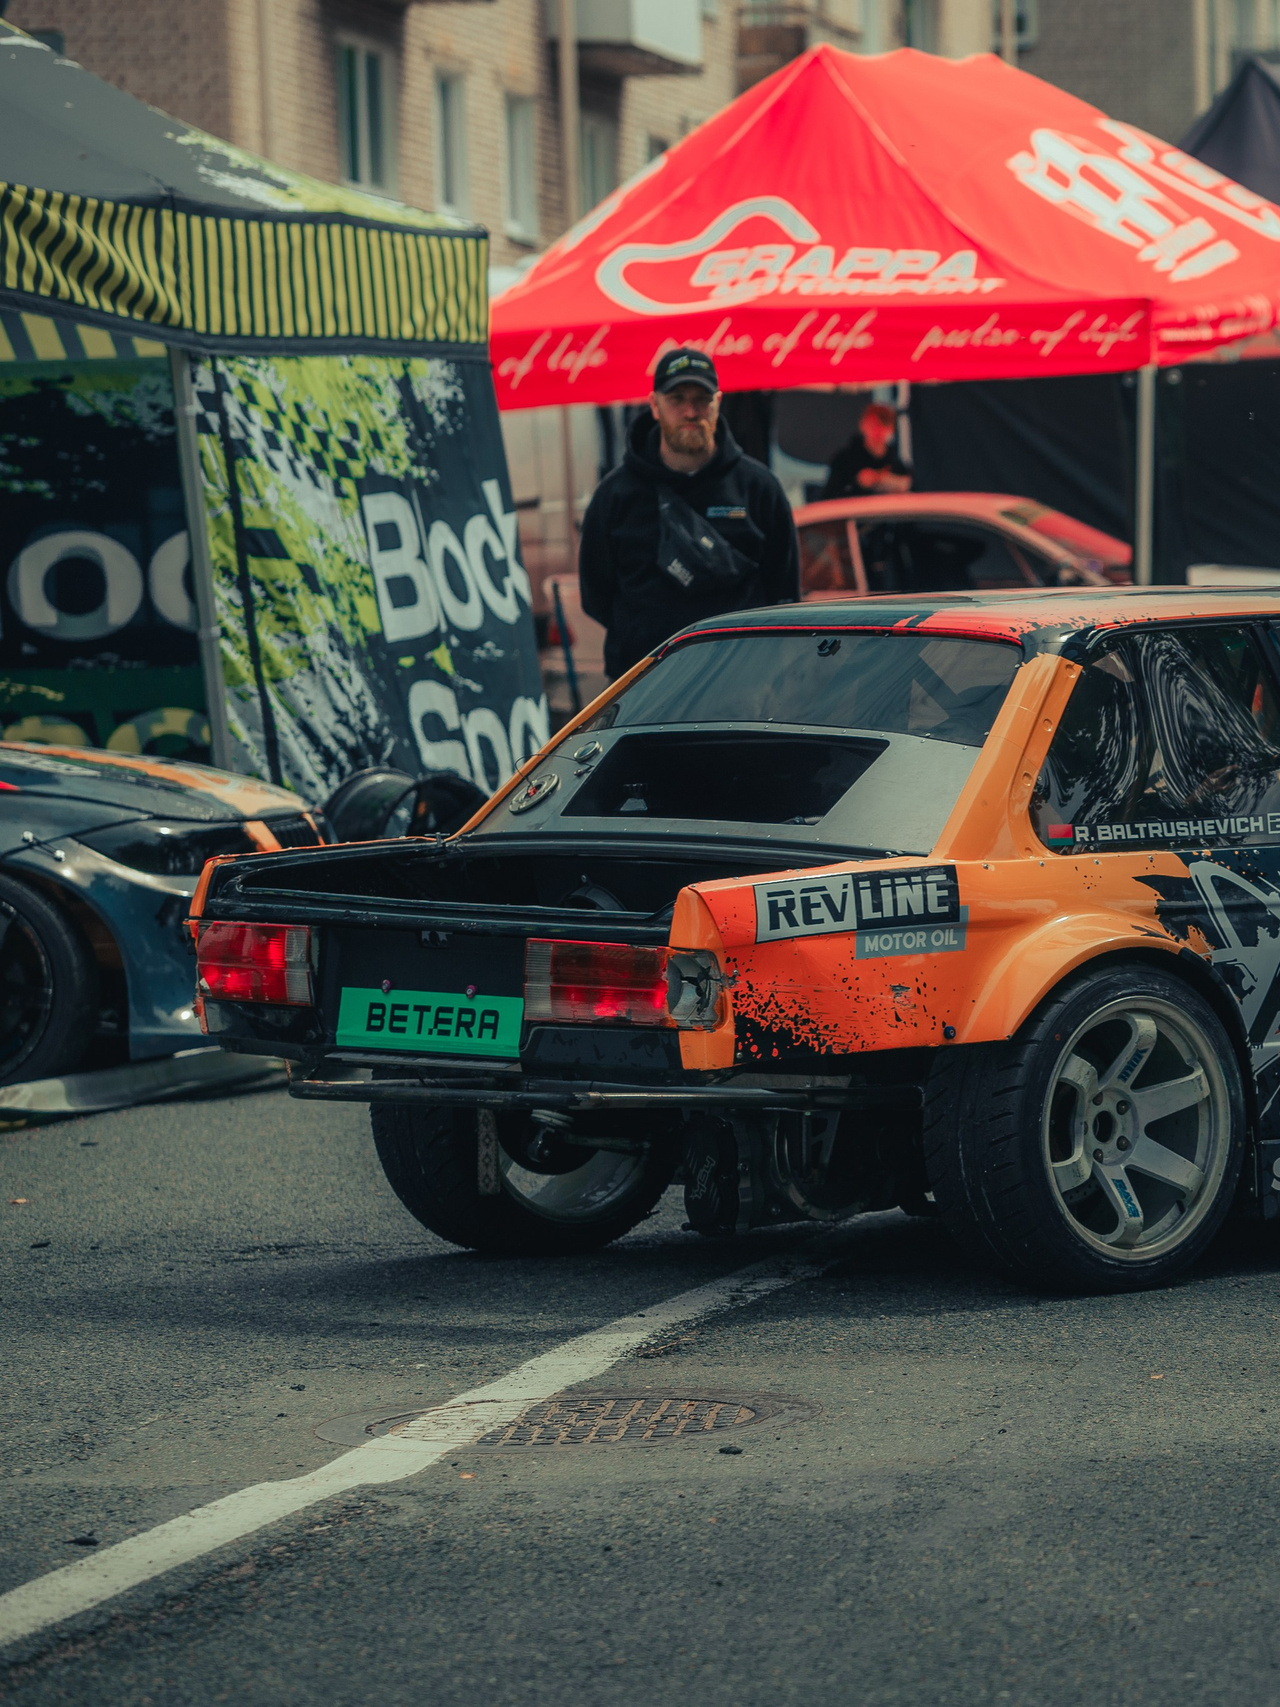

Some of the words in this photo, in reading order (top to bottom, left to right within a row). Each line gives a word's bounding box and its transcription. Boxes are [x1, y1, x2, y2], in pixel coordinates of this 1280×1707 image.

[689, 244, 978, 287] GRAPPA
[498, 329, 552, 390] of
[546, 324, 611, 385] life
[762, 309, 819, 369] of
[812, 309, 878, 366] life
[910, 311, 1021, 363] pulse
[1029, 309, 1087, 358] of
[1075, 826, 1095, 842] R.
[1097, 816, 1264, 841] BALTRUSHEVICH
[864, 931, 926, 952] MOTOR
[931, 929, 958, 946] OIL
